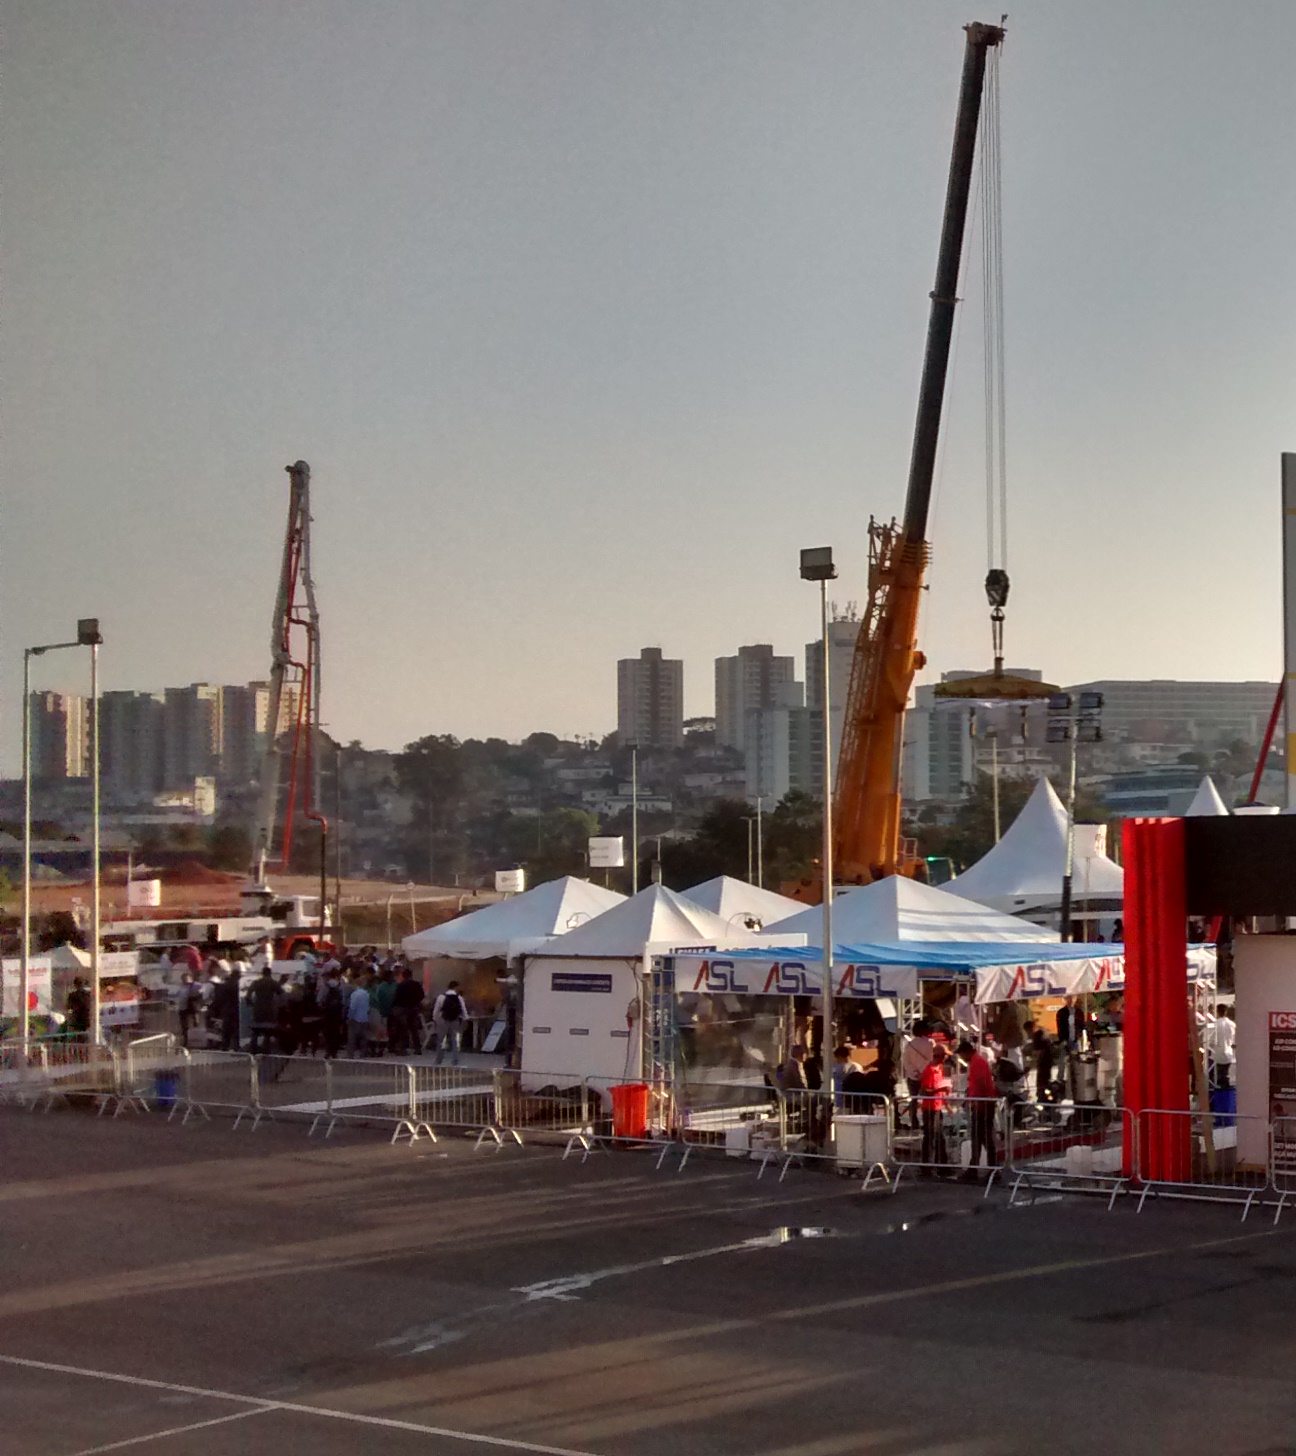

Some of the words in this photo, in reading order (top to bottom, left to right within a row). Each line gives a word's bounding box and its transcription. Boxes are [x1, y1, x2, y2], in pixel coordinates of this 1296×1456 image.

[693, 961, 749, 993] ASL
[763, 962, 821, 995] ASL
[835, 964, 898, 997] ASL
[1006, 964, 1067, 999] ASL
